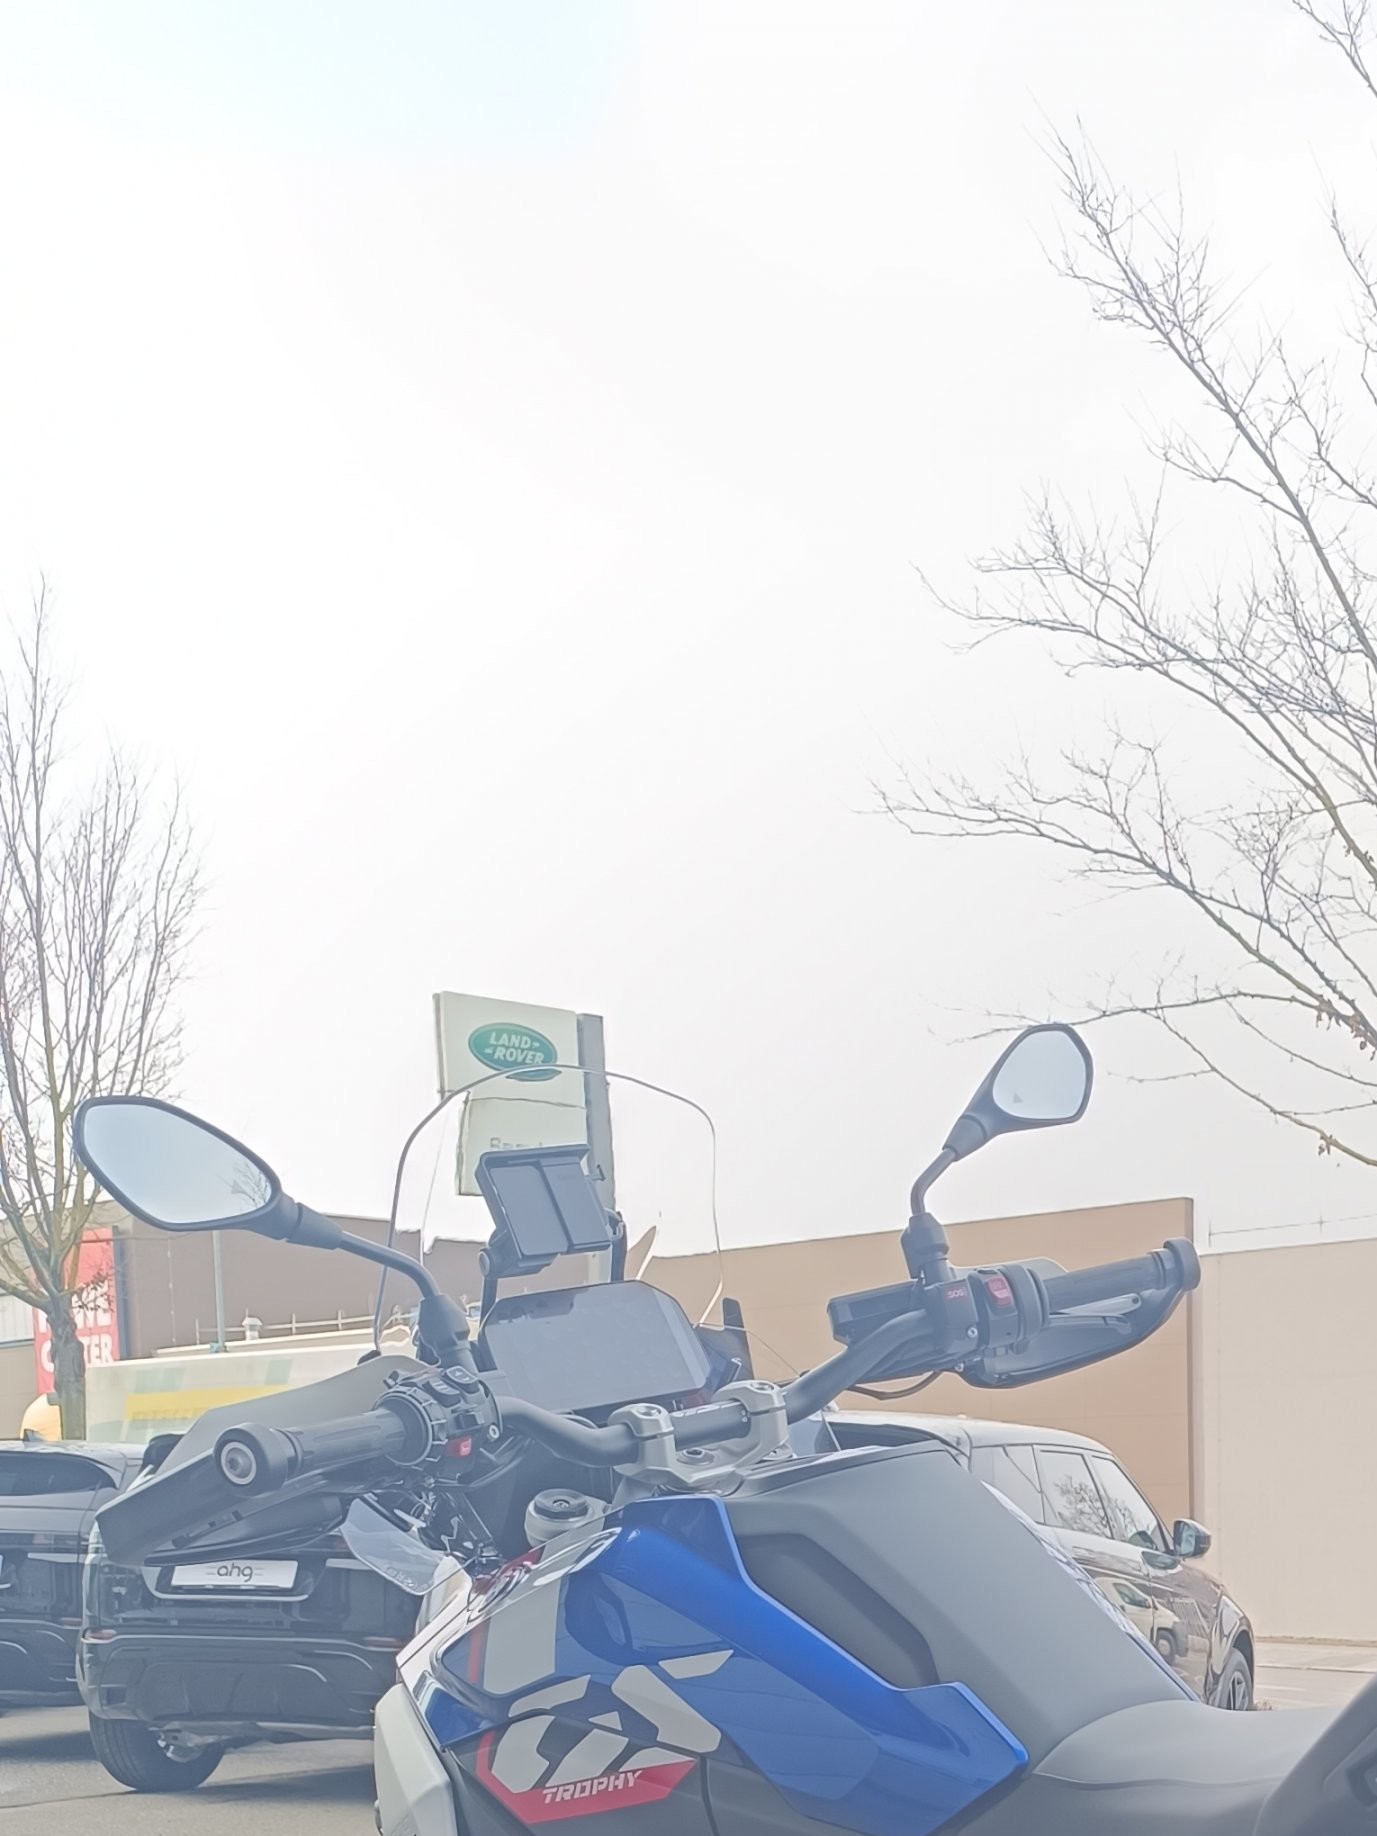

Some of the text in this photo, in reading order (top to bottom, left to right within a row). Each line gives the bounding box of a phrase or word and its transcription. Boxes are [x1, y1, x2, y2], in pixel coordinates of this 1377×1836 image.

[489, 1032, 532, 1049] LAND
[493, 1046, 545, 1065] ROVER
[40, 1333, 114, 1374] CTER
[216, 1562, 254, 1583] ahg
[542, 1770, 644, 1805] TROPHY
